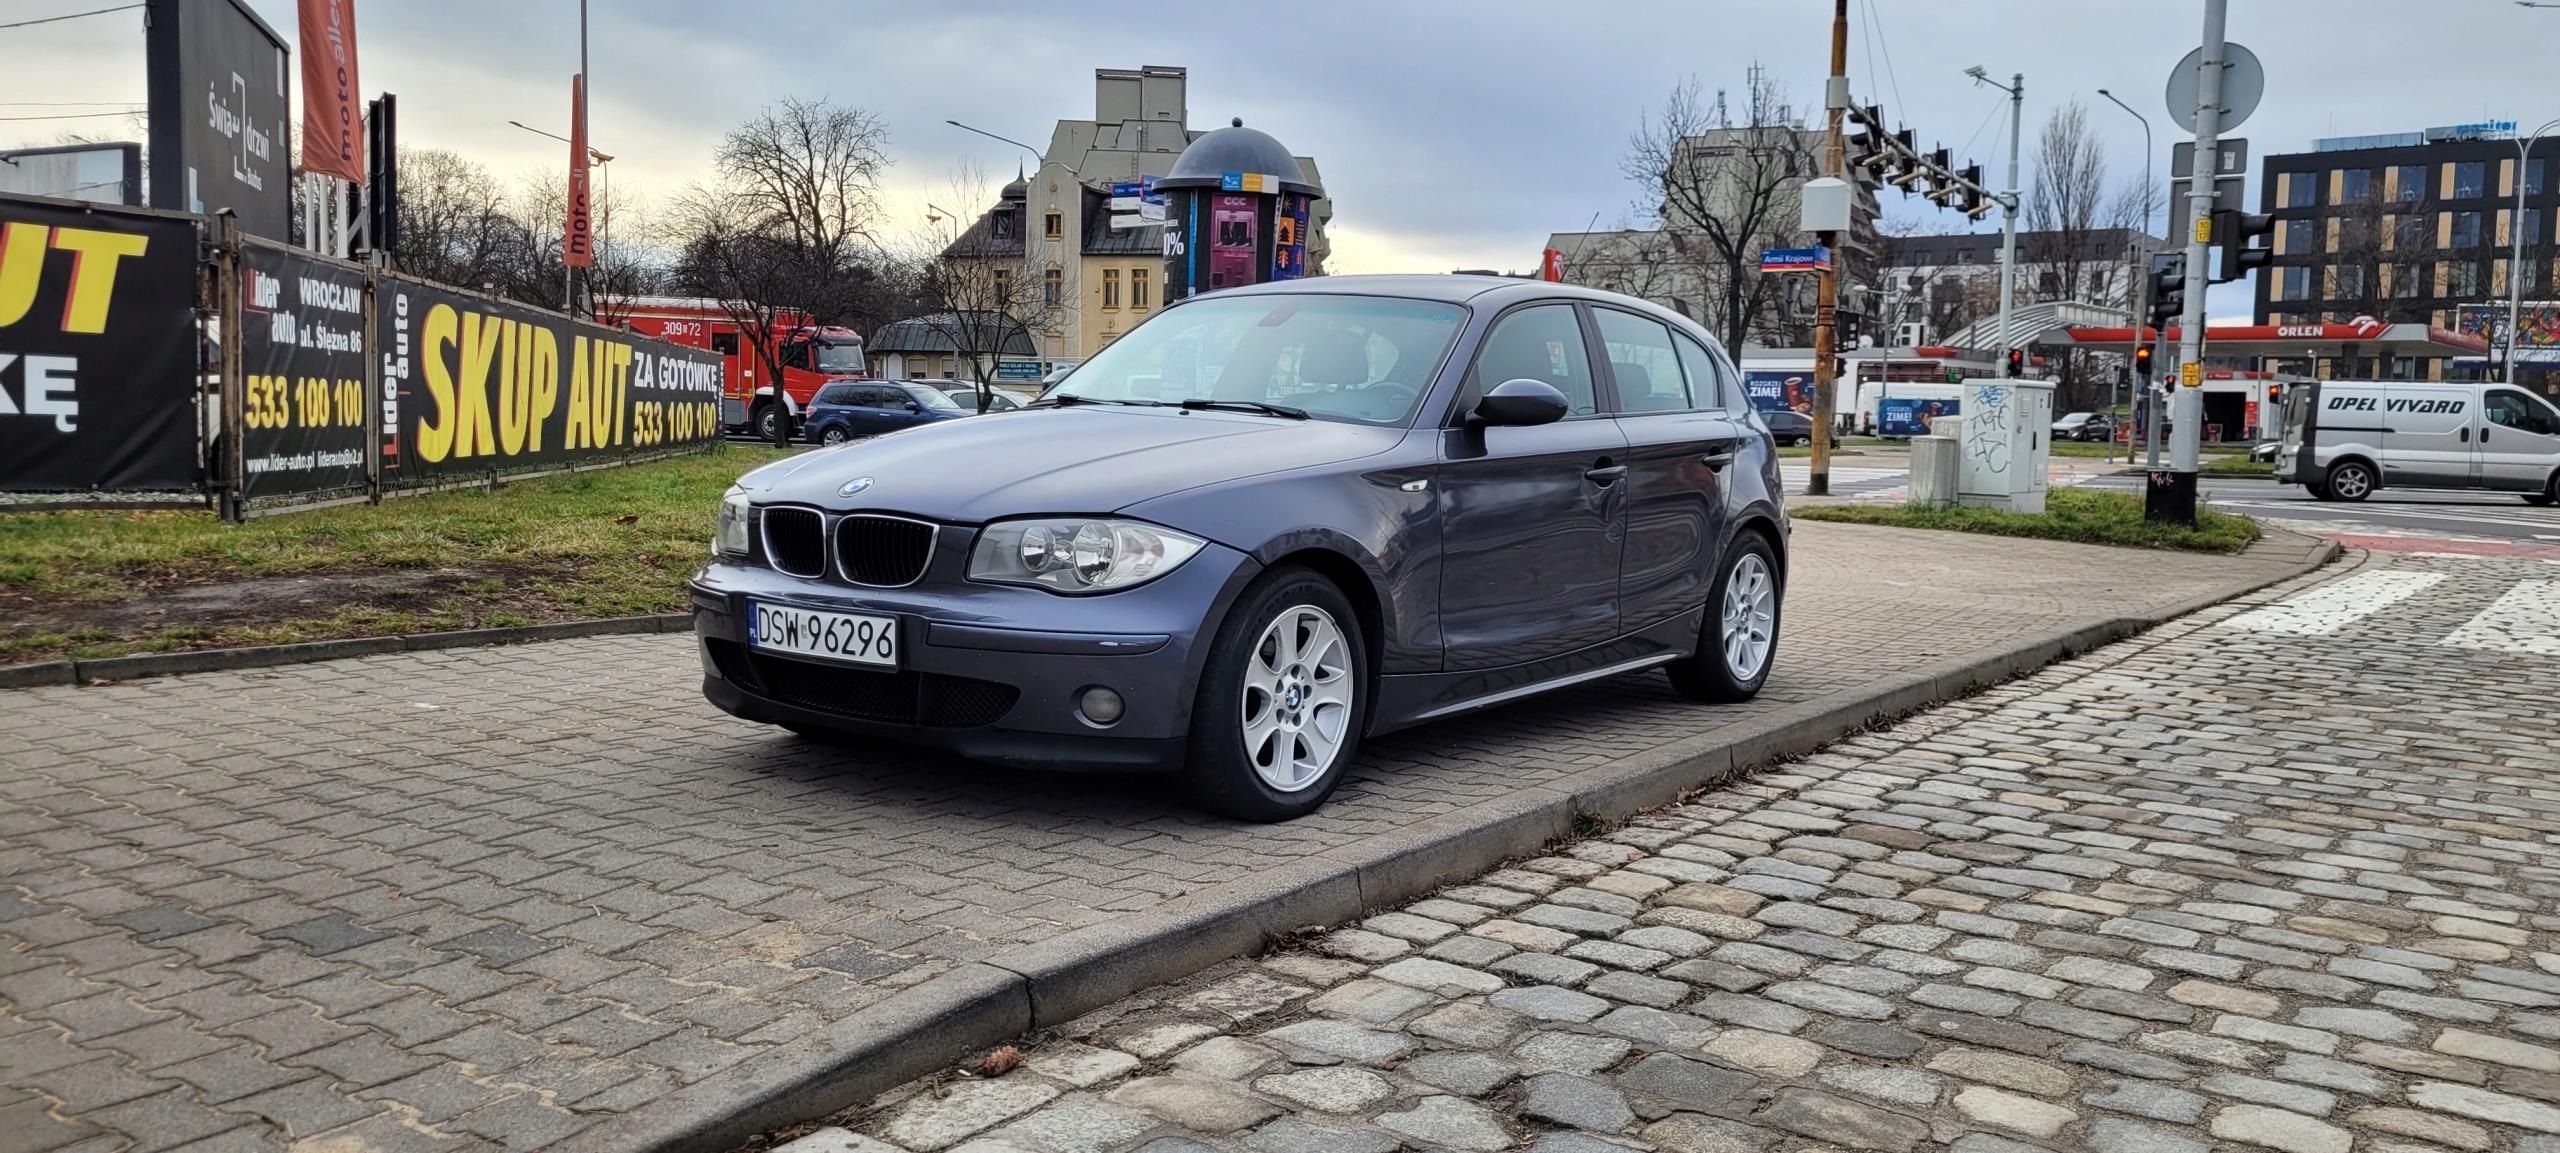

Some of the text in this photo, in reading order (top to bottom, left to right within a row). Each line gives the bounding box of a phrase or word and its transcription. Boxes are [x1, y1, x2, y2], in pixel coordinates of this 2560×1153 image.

[247, 116, 270, 162] drzwi
[1223, 196, 1247, 206] CCC
[1764, 255, 1784, 263] Armii
[299, 276, 361, 315] WROCŁAW
[271, 309, 296, 345] auto
[300, 320, 362, 357] ul. Ślężna 86
[394, 293, 409, 380] auto
[663, 321, 682, 335] 309
[688, 322, 701, 336] 72
[2277, 326, 2324, 337] ORLEN
[417, 303, 559, 464] SKUP
[564, 335, 633, 450] AUT
[634, 351, 655, 389] ZA
[658, 353, 718, 400] GOTÓWKĘ
[1749, 386, 1782, 400] ZIMĘ!
[245, 374, 363, 430] 533 100 100
[1886, 411, 1913, 425] ZIMĘ!
[2327, 396, 2466, 415] OPEL VIVARO
[633, 400, 717, 447] 533 100 100
[246, 451, 315, 474] www.lider-auto.pl
[749, 627, 758, 639] PL
[757, 606, 894, 660] DSW 96296
